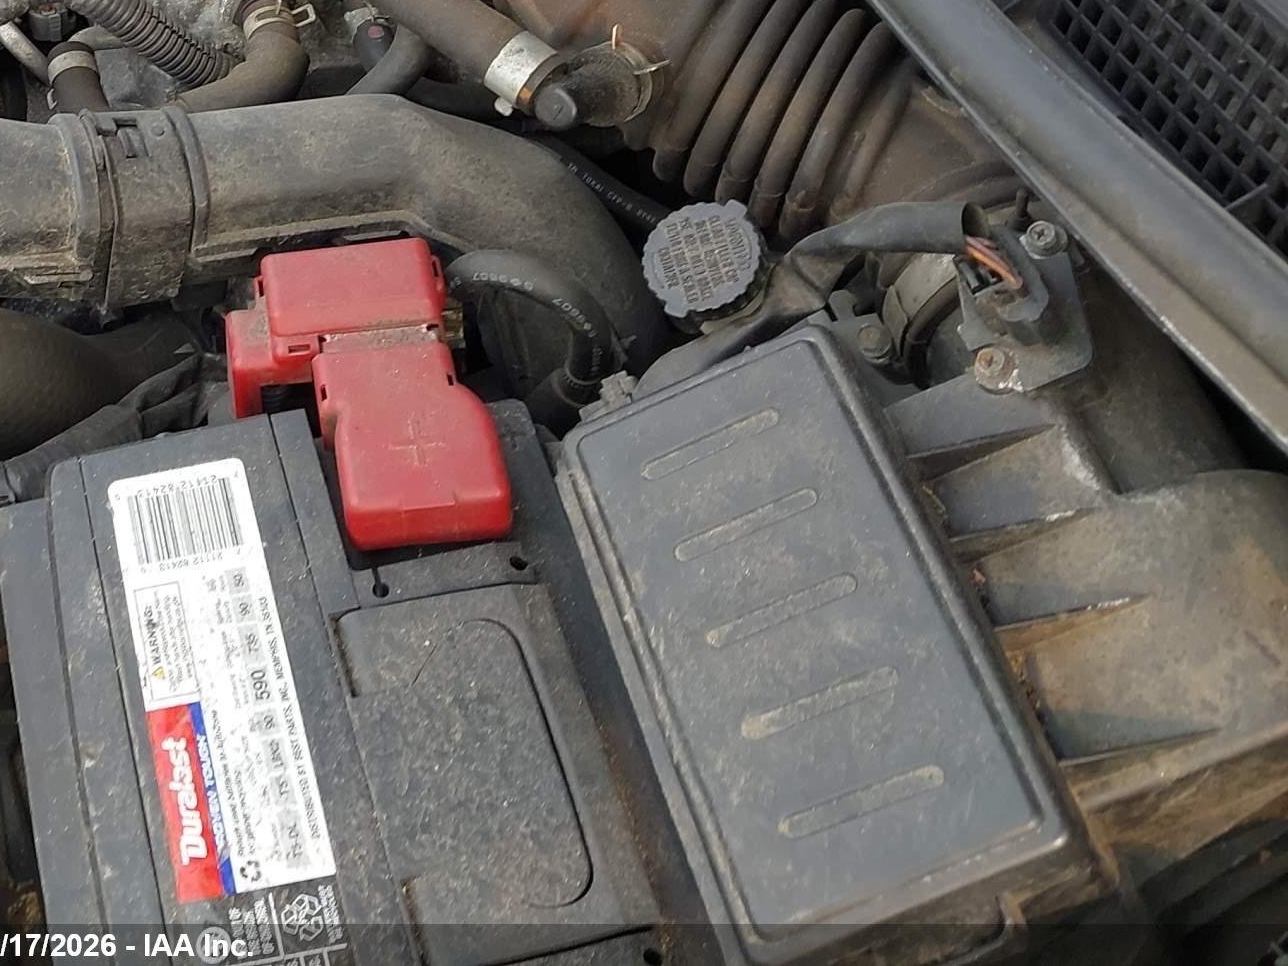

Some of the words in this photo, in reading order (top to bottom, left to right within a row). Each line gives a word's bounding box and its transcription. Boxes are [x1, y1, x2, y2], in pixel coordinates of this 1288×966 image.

[251, 669, 270, 700] 590
[195, 732, 215, 787] TOUGH
[162, 736, 208, 866] Duralast
